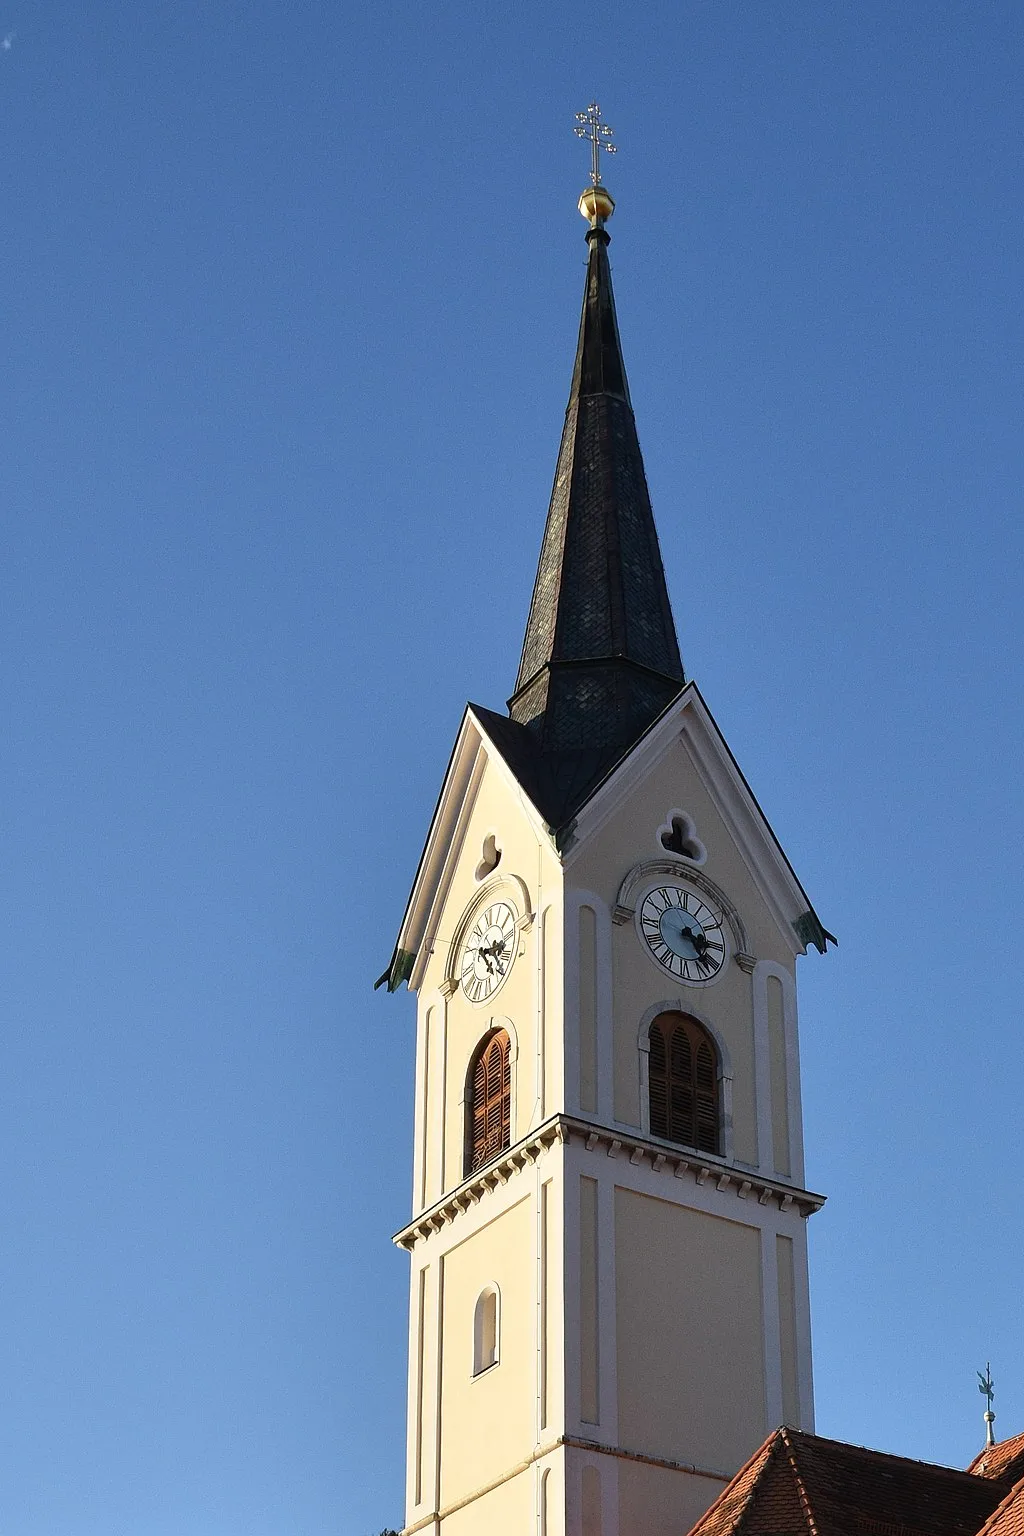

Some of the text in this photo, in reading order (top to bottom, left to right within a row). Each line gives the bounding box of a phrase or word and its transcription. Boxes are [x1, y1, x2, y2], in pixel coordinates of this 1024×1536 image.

[647, 896, 663, 915] X
[658, 889, 673, 908] XI
[676, 890, 689, 910] XII
[694, 904, 703, 916] I
[646, 933, 664, 952] VIII
[660, 949, 674, 968] VII
[680, 959, 691, 978] VI
[695, 961, 708, 979] V
